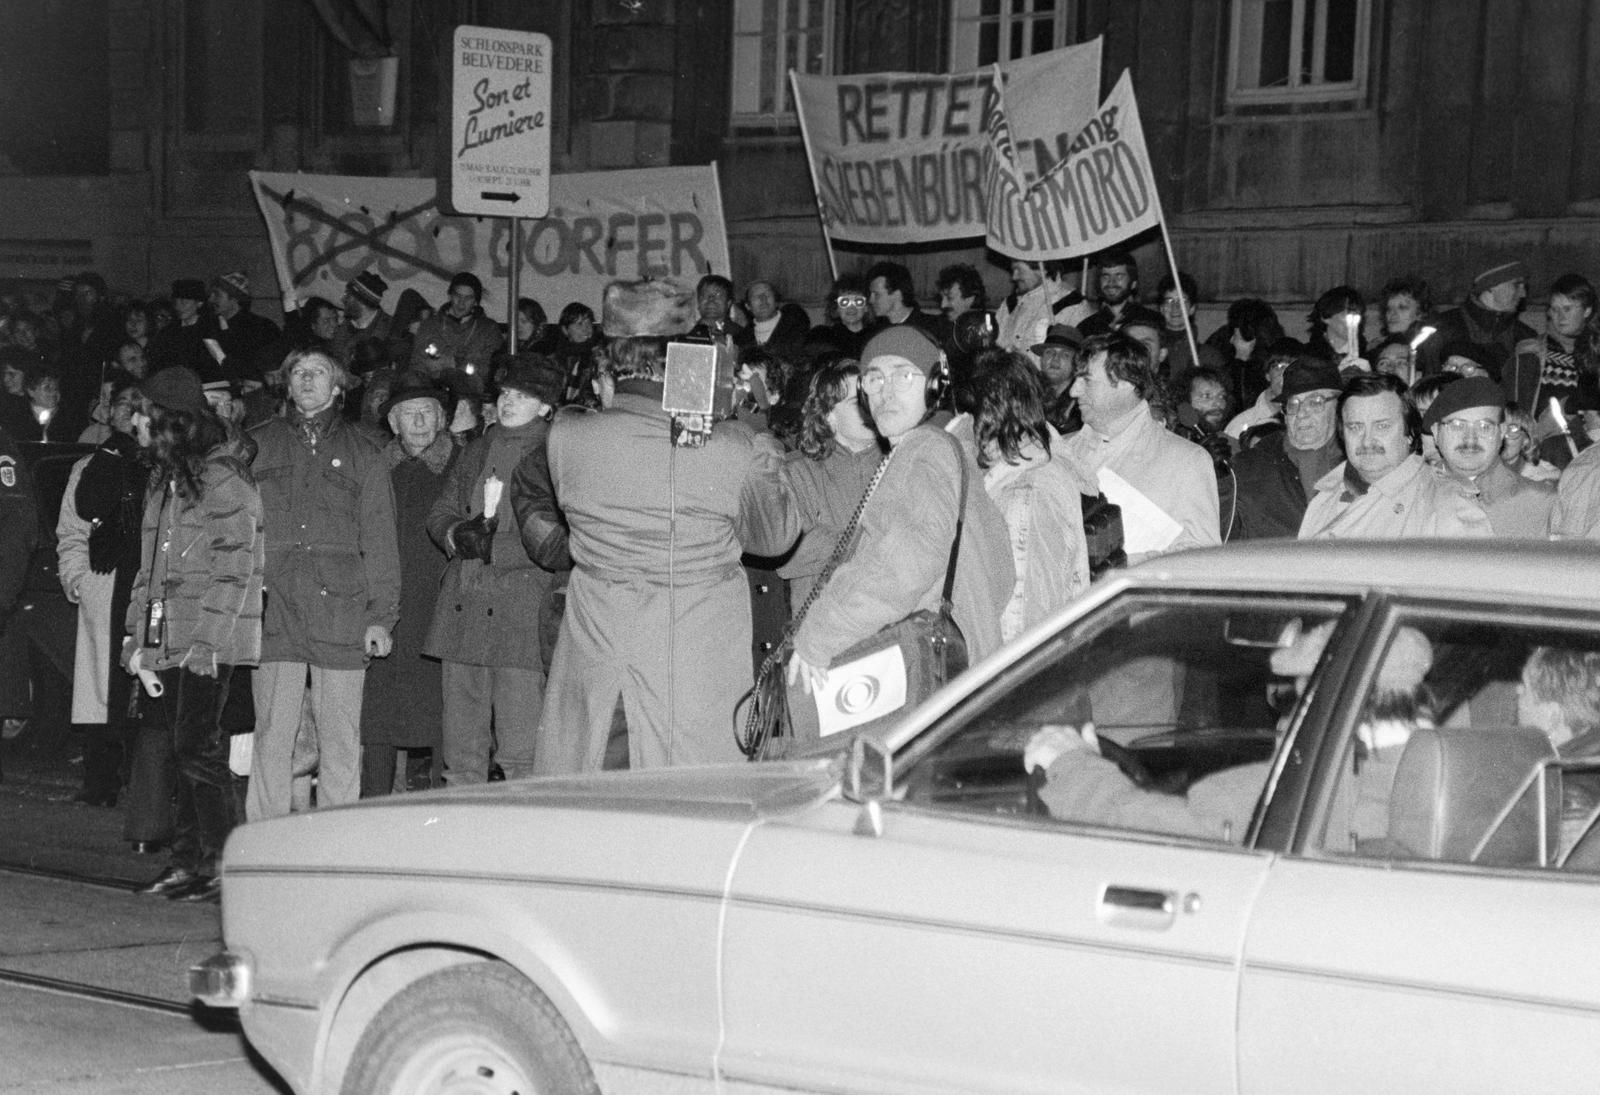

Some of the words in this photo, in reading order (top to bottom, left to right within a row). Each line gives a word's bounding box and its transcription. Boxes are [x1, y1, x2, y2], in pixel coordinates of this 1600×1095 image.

[460, 36, 544, 57] SCHLOSSPARK
[462, 52, 544, 74] BELVEDERE
[468, 77, 509, 116] Son
[512, 76, 532, 101] et
